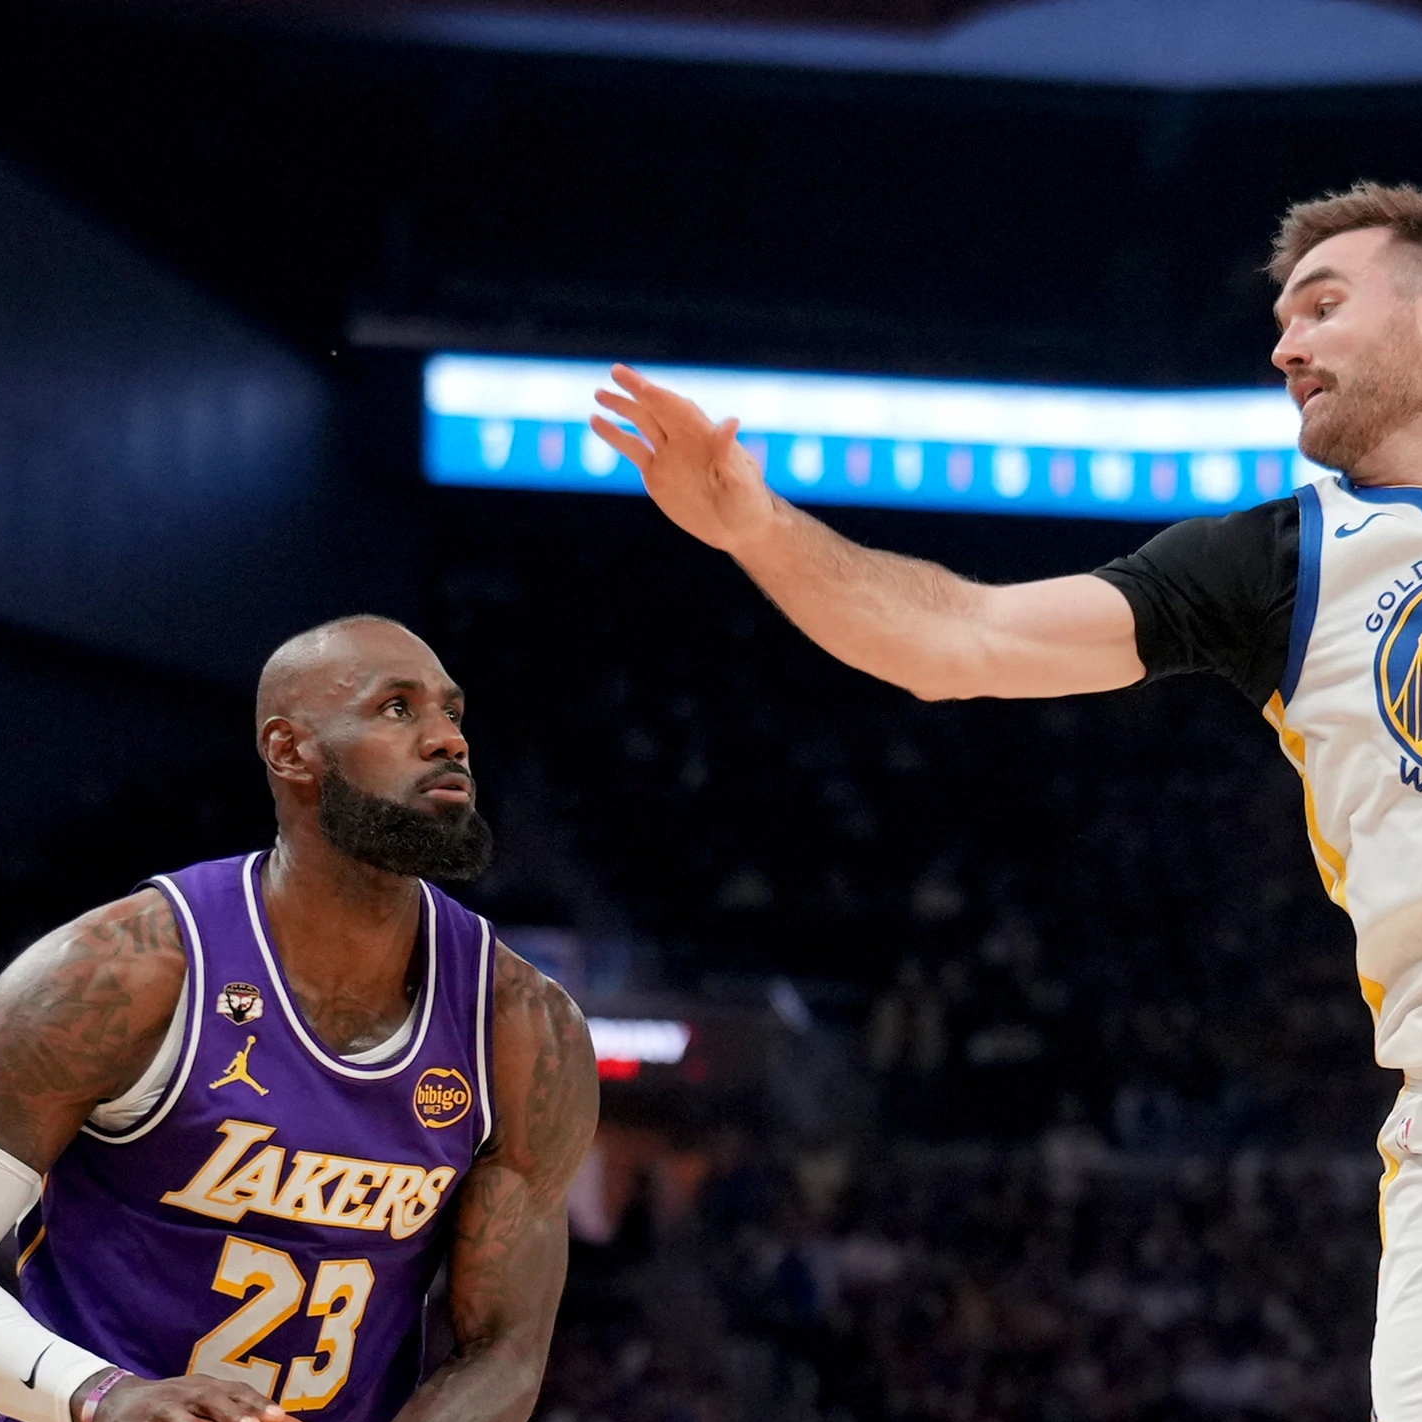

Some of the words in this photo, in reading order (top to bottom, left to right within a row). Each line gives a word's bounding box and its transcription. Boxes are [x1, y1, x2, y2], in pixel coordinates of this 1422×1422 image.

[418, 1083, 467, 1111] bibigo
[160, 1119, 456, 1240] LAKERS
[186, 1235, 376, 1412] 23
